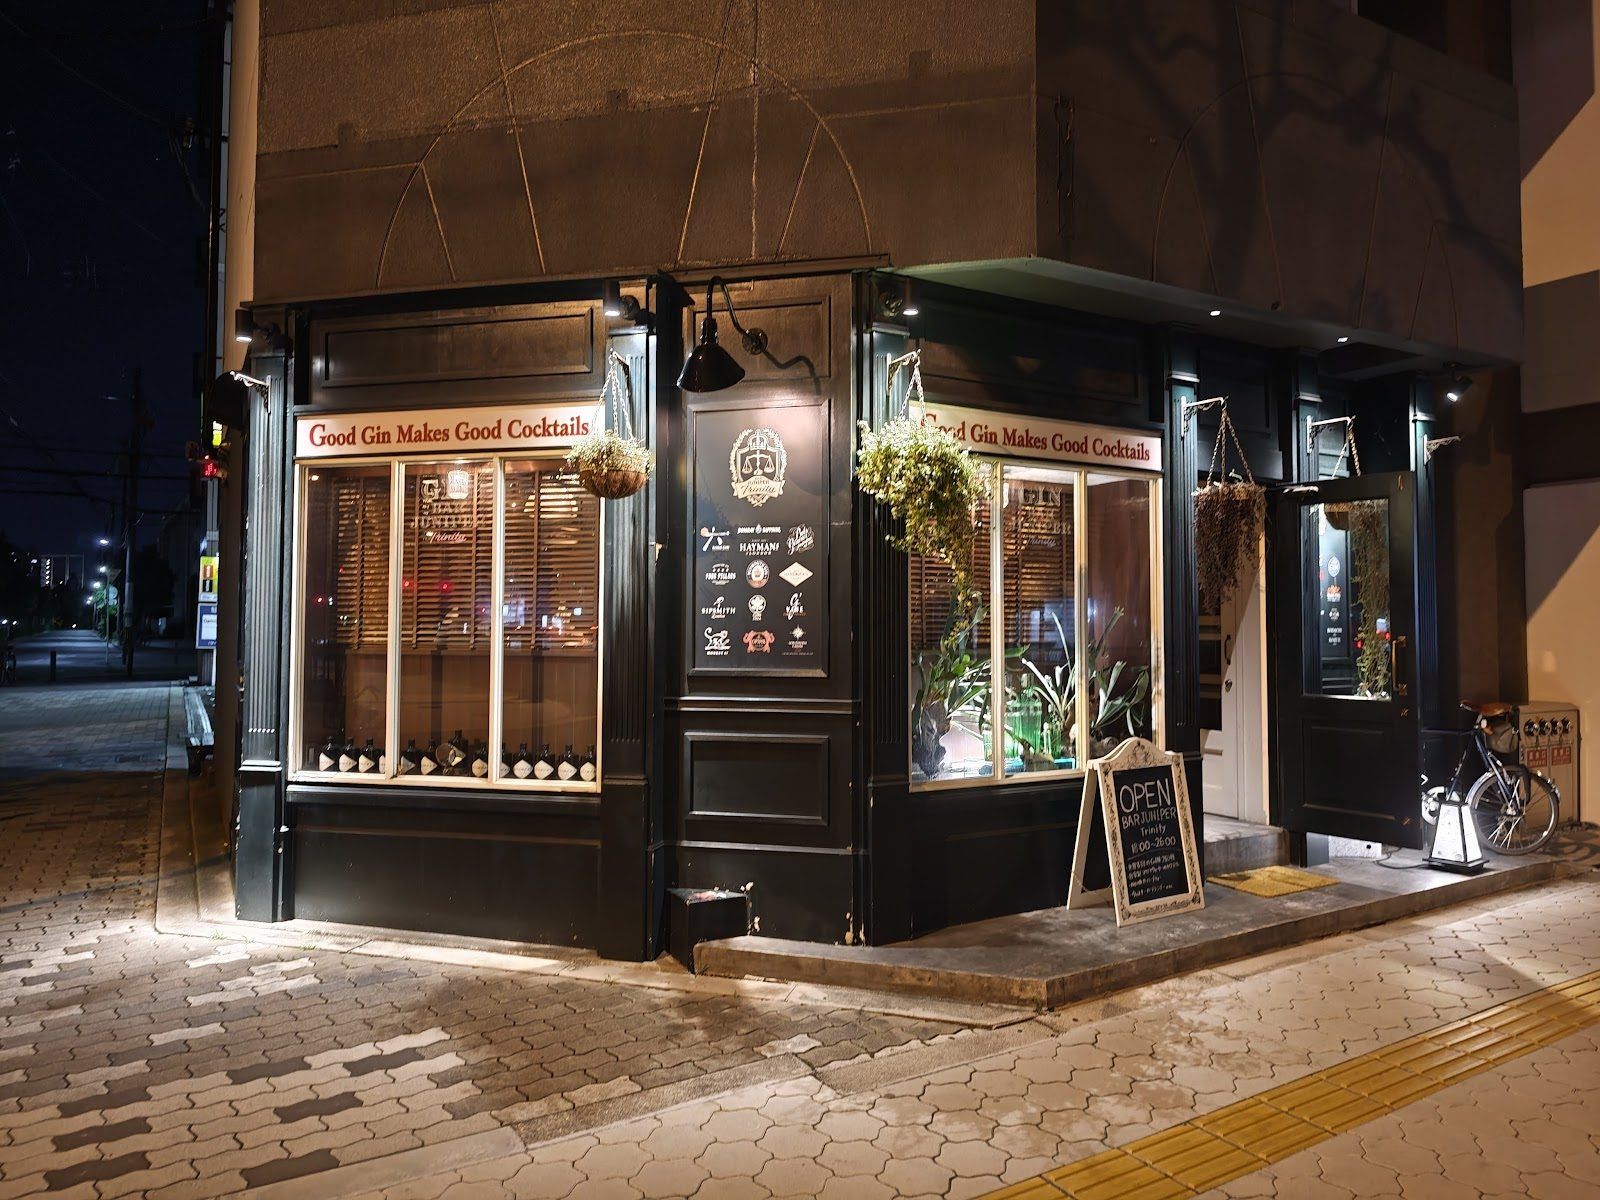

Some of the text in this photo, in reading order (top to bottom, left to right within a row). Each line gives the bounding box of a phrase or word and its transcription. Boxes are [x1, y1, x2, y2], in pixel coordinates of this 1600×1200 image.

[309, 415, 589, 447] Good Gin Makes Good Cocktails
[970, 423, 998, 445] Gin
[1003, 427, 1047, 450] Makes
[1051, 434, 1089, 455] Good
[1092, 439, 1150, 461] Cocktails
[1119, 778, 1171, 813] OPEN
[1140, 823, 1166, 837] Trinity
